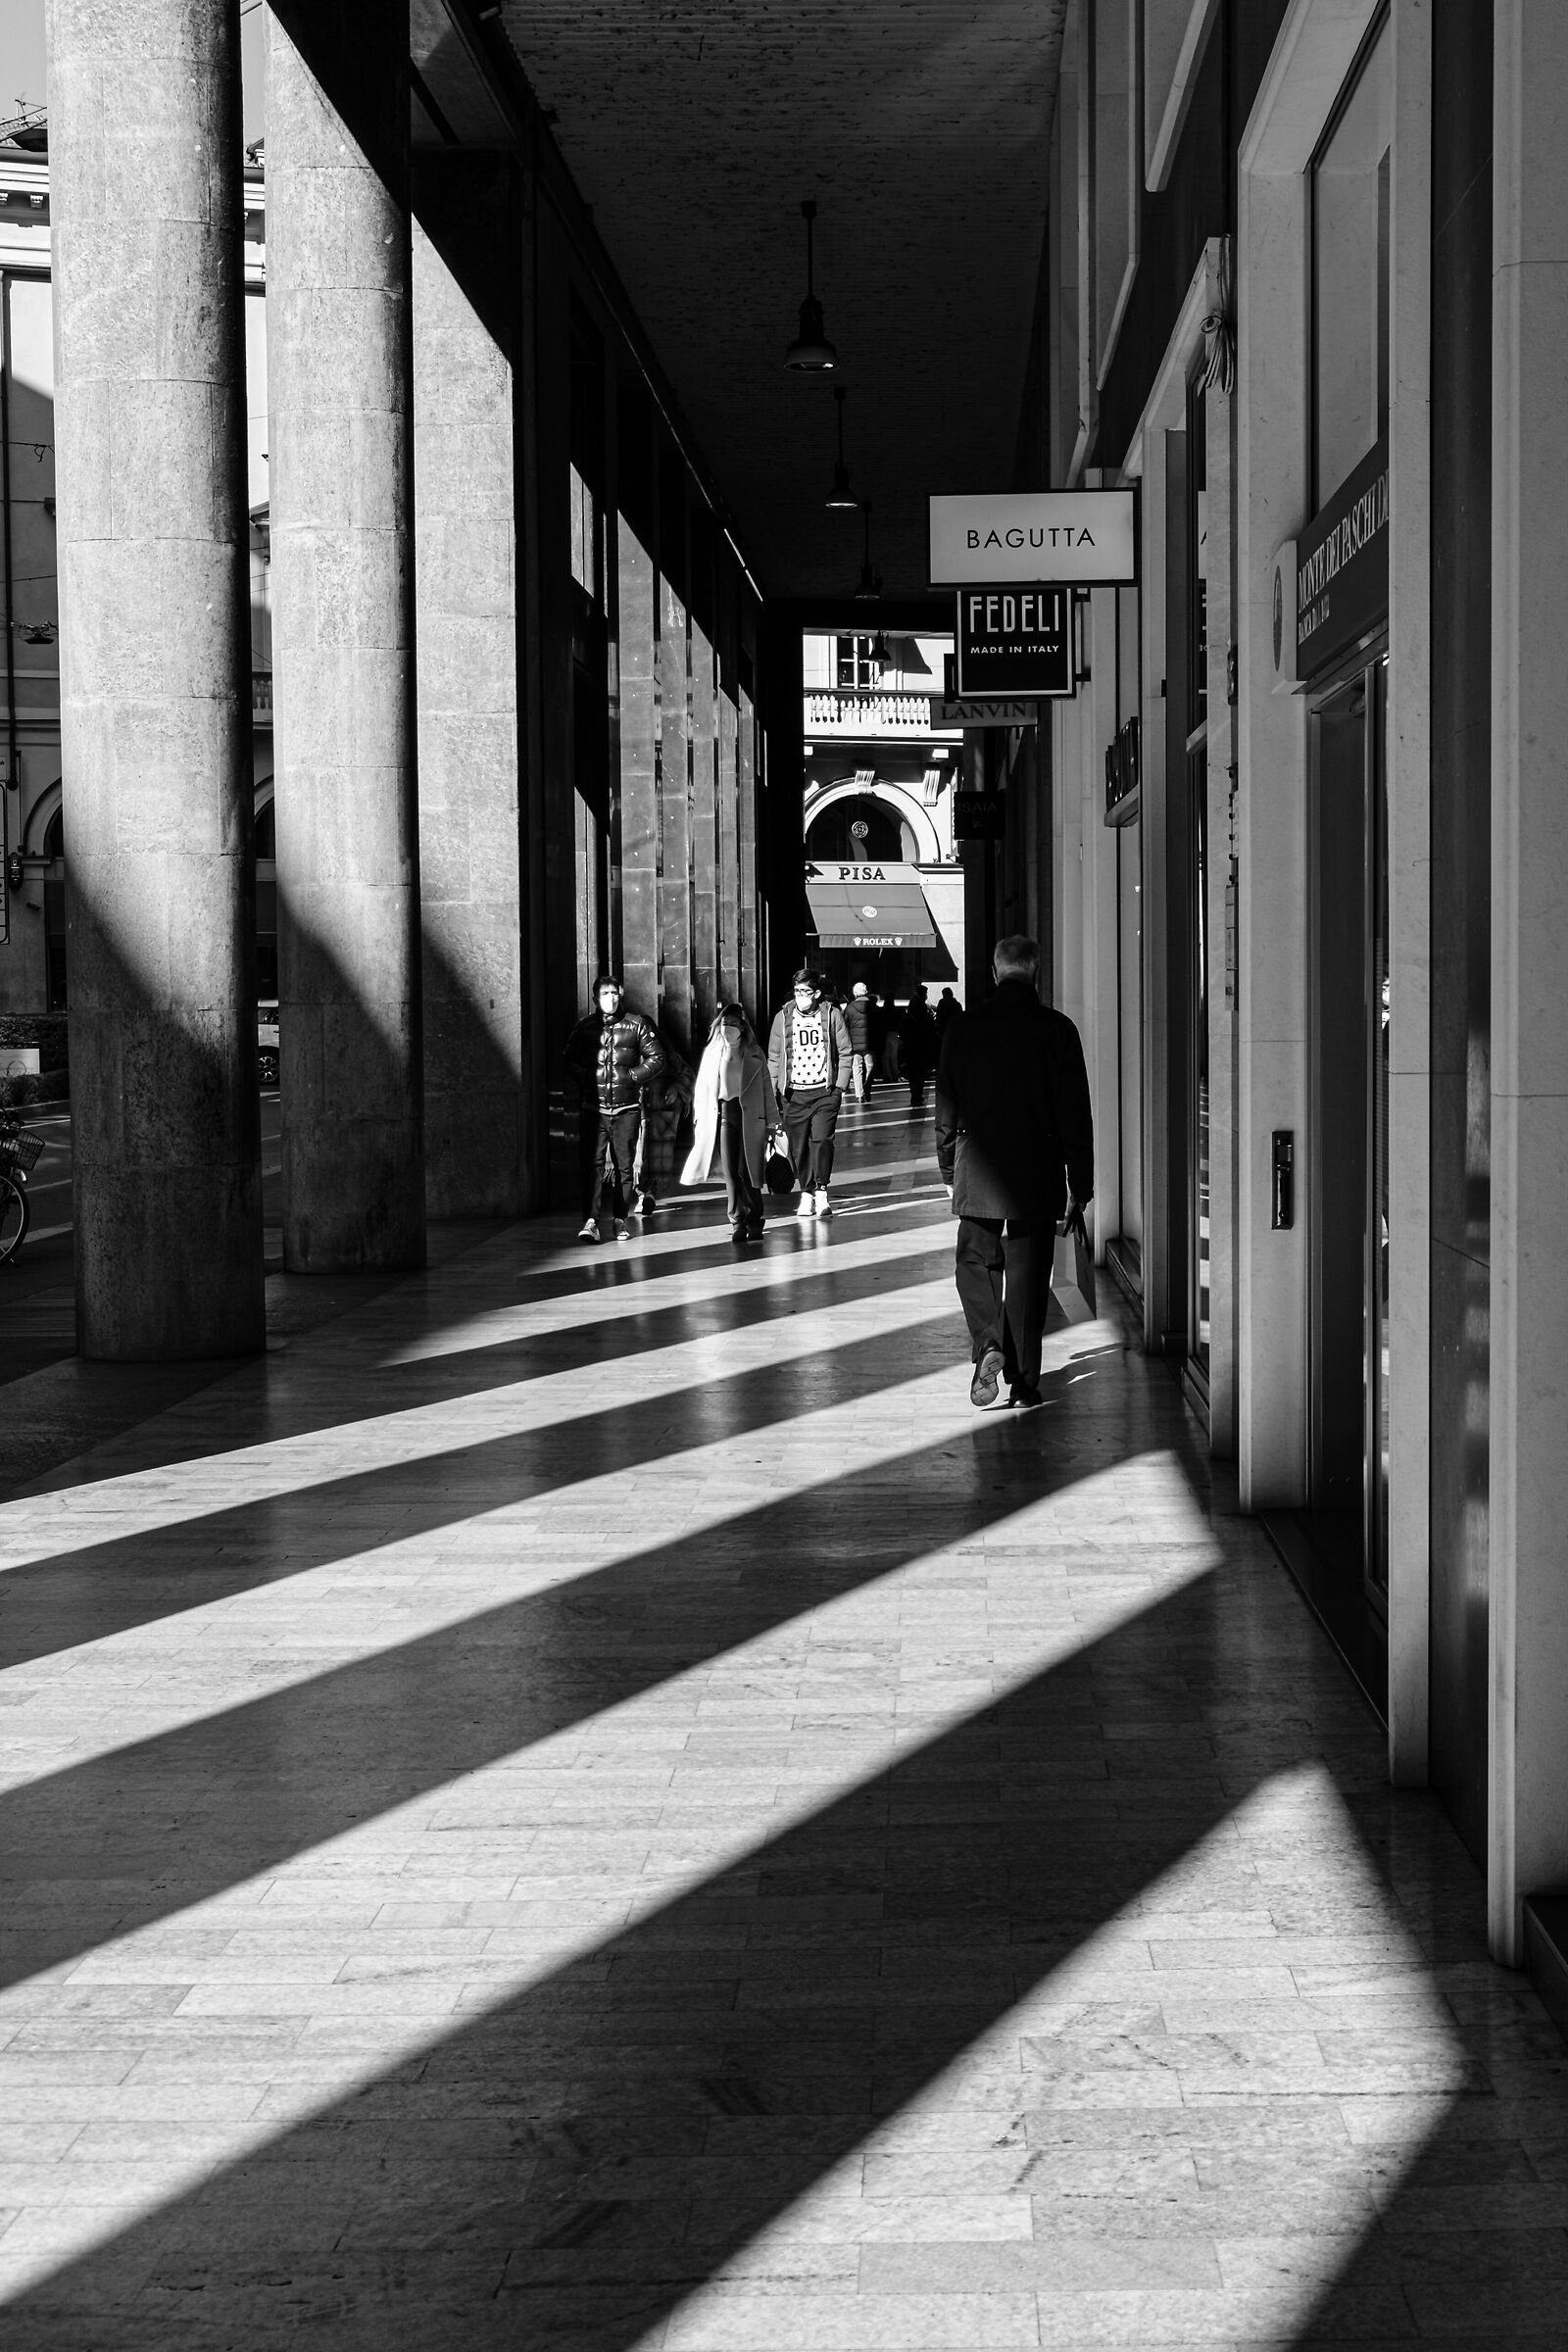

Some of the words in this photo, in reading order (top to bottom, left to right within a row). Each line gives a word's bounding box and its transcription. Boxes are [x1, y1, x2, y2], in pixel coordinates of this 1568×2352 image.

[967, 527, 1096, 549] BAGUTTA
[1298, 542, 1325, 615] MONTE
[1326, 524, 1341, 583] DEI
[1341, 482, 1377, 566] PASCHI
[969, 594, 1059, 633] FEDELI
[970, 646, 1004, 655] MADE
[1028, 645, 1059, 654] ITALY
[941, 703, 1027, 720] LANVIN
[956, 801, 998, 814] ISAIA
[838, 866, 886, 881] PISA
[799, 1029, 819, 1046] DG
